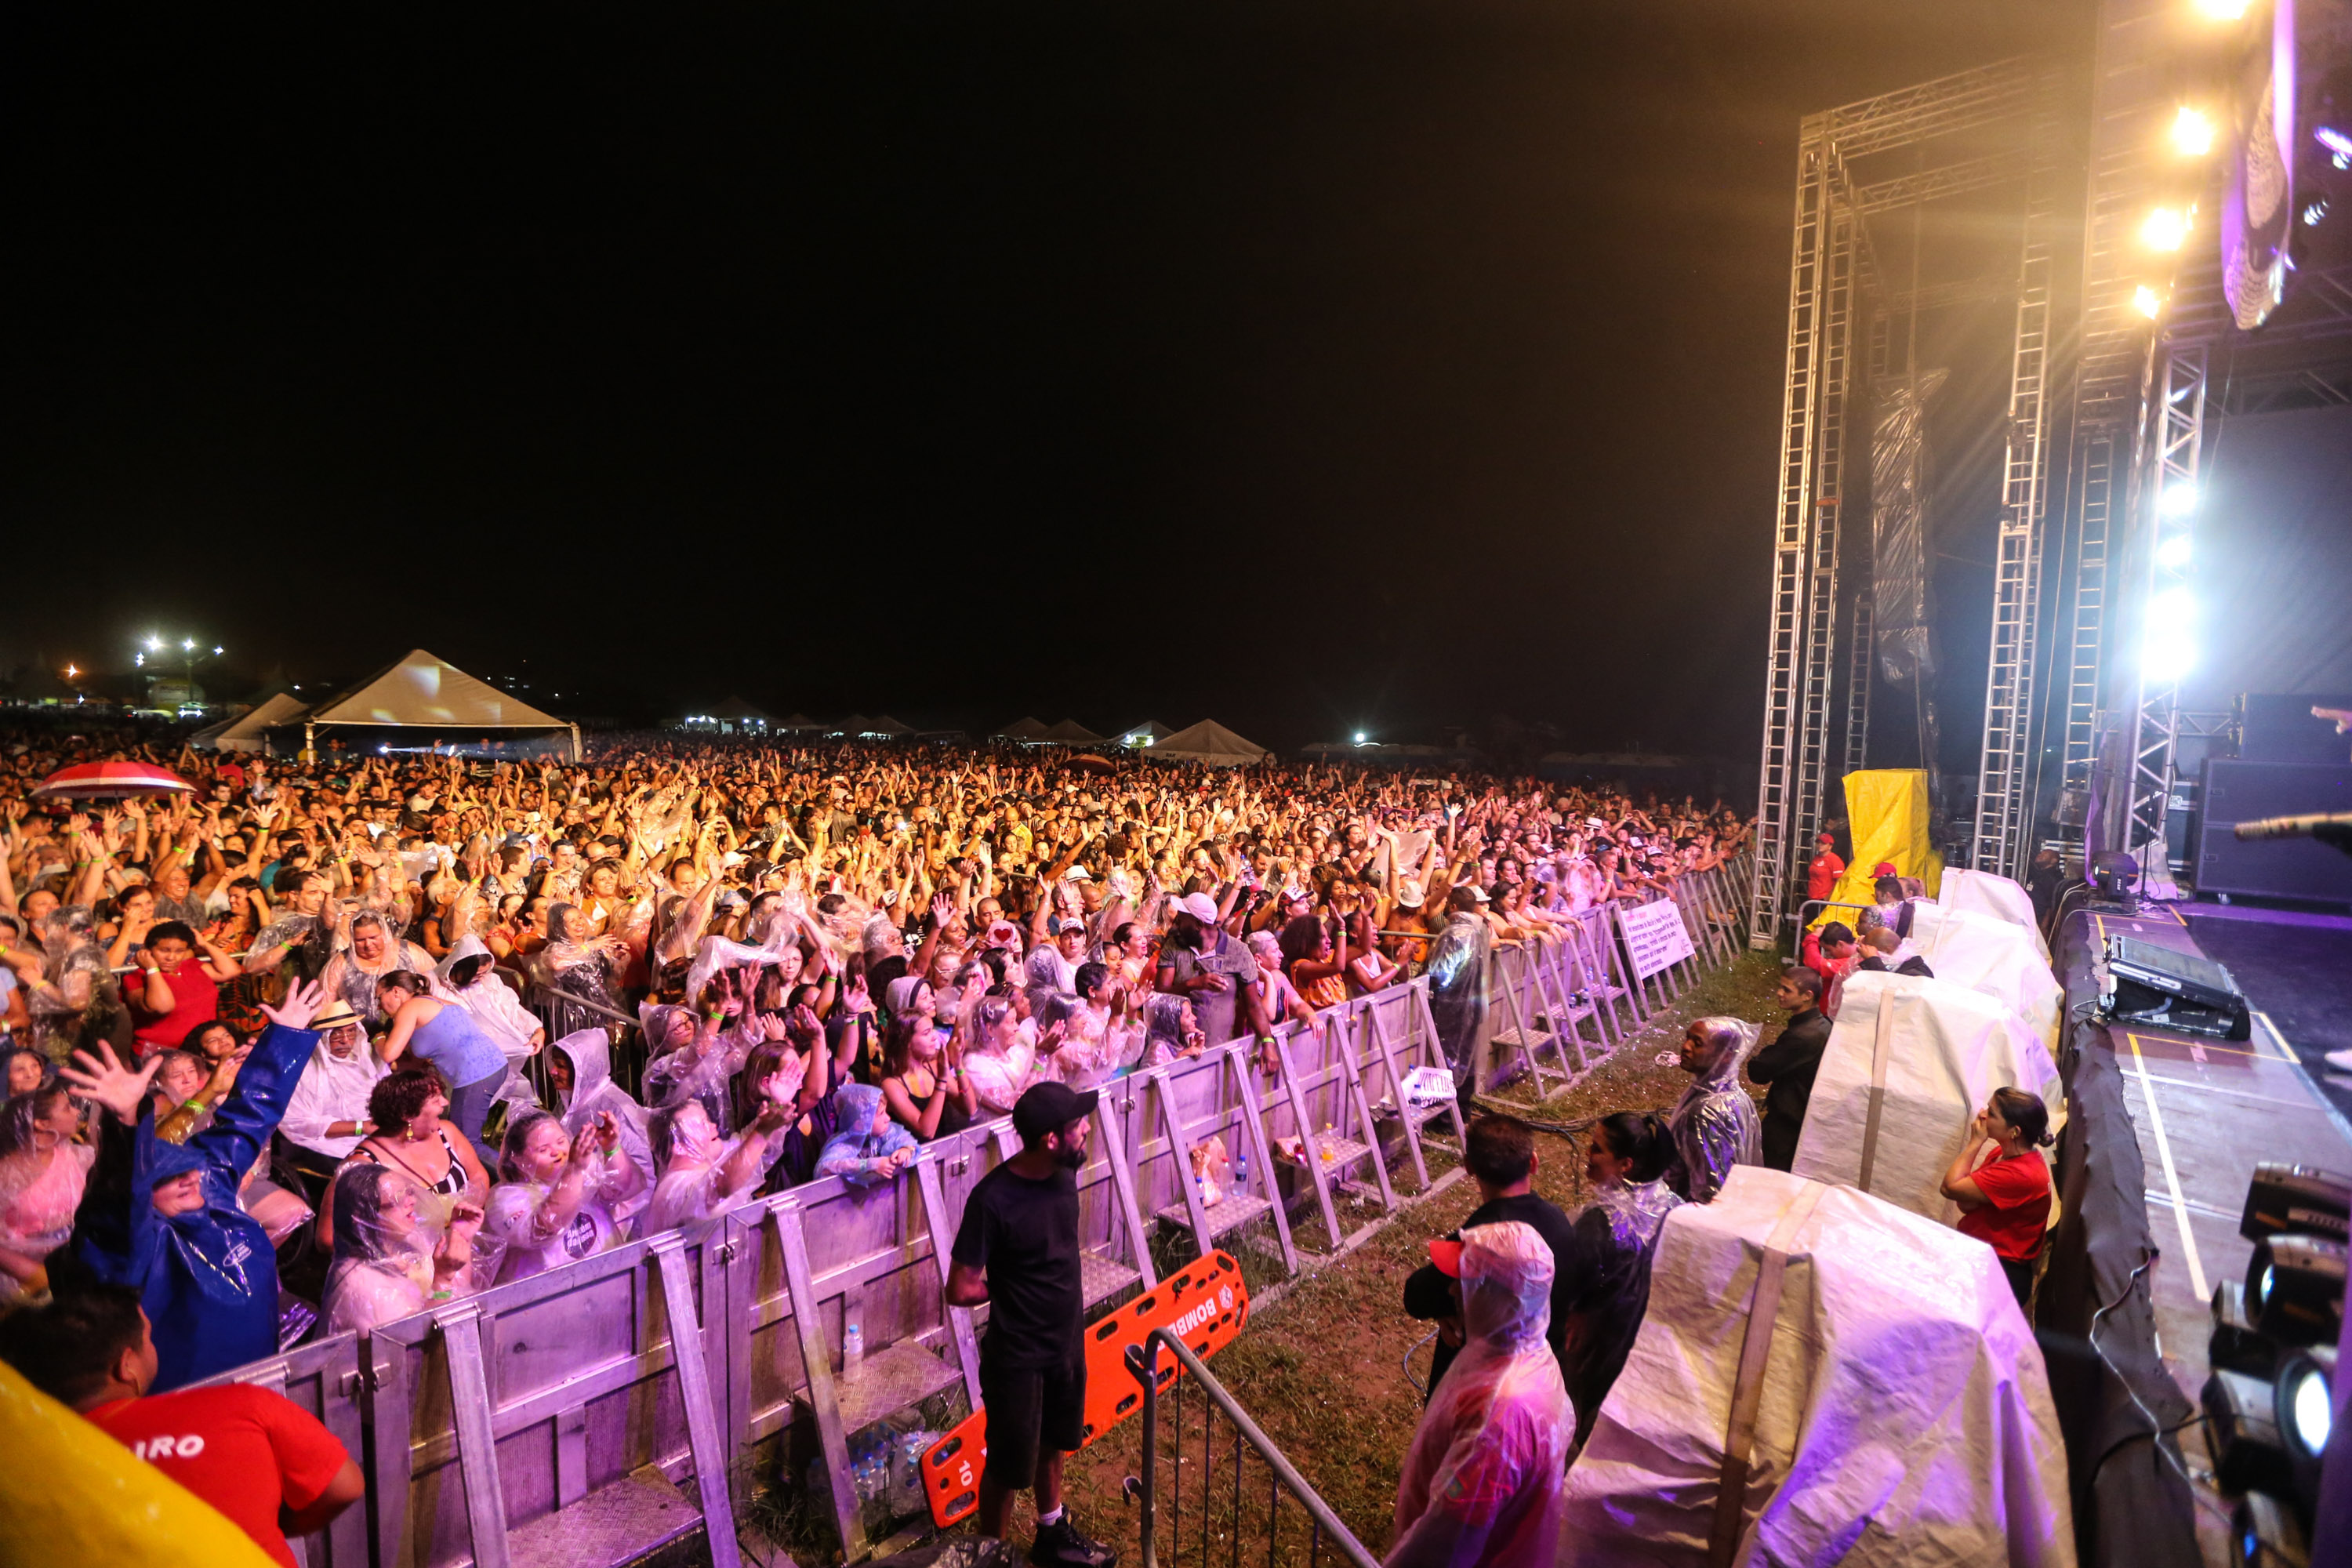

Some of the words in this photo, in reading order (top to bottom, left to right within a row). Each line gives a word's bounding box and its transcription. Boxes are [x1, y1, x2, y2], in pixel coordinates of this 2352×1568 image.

[1156, 1298, 1217, 1352] BOMBE
[136, 1434, 205, 1463] IRO
[958, 1459, 973, 1486] 10
